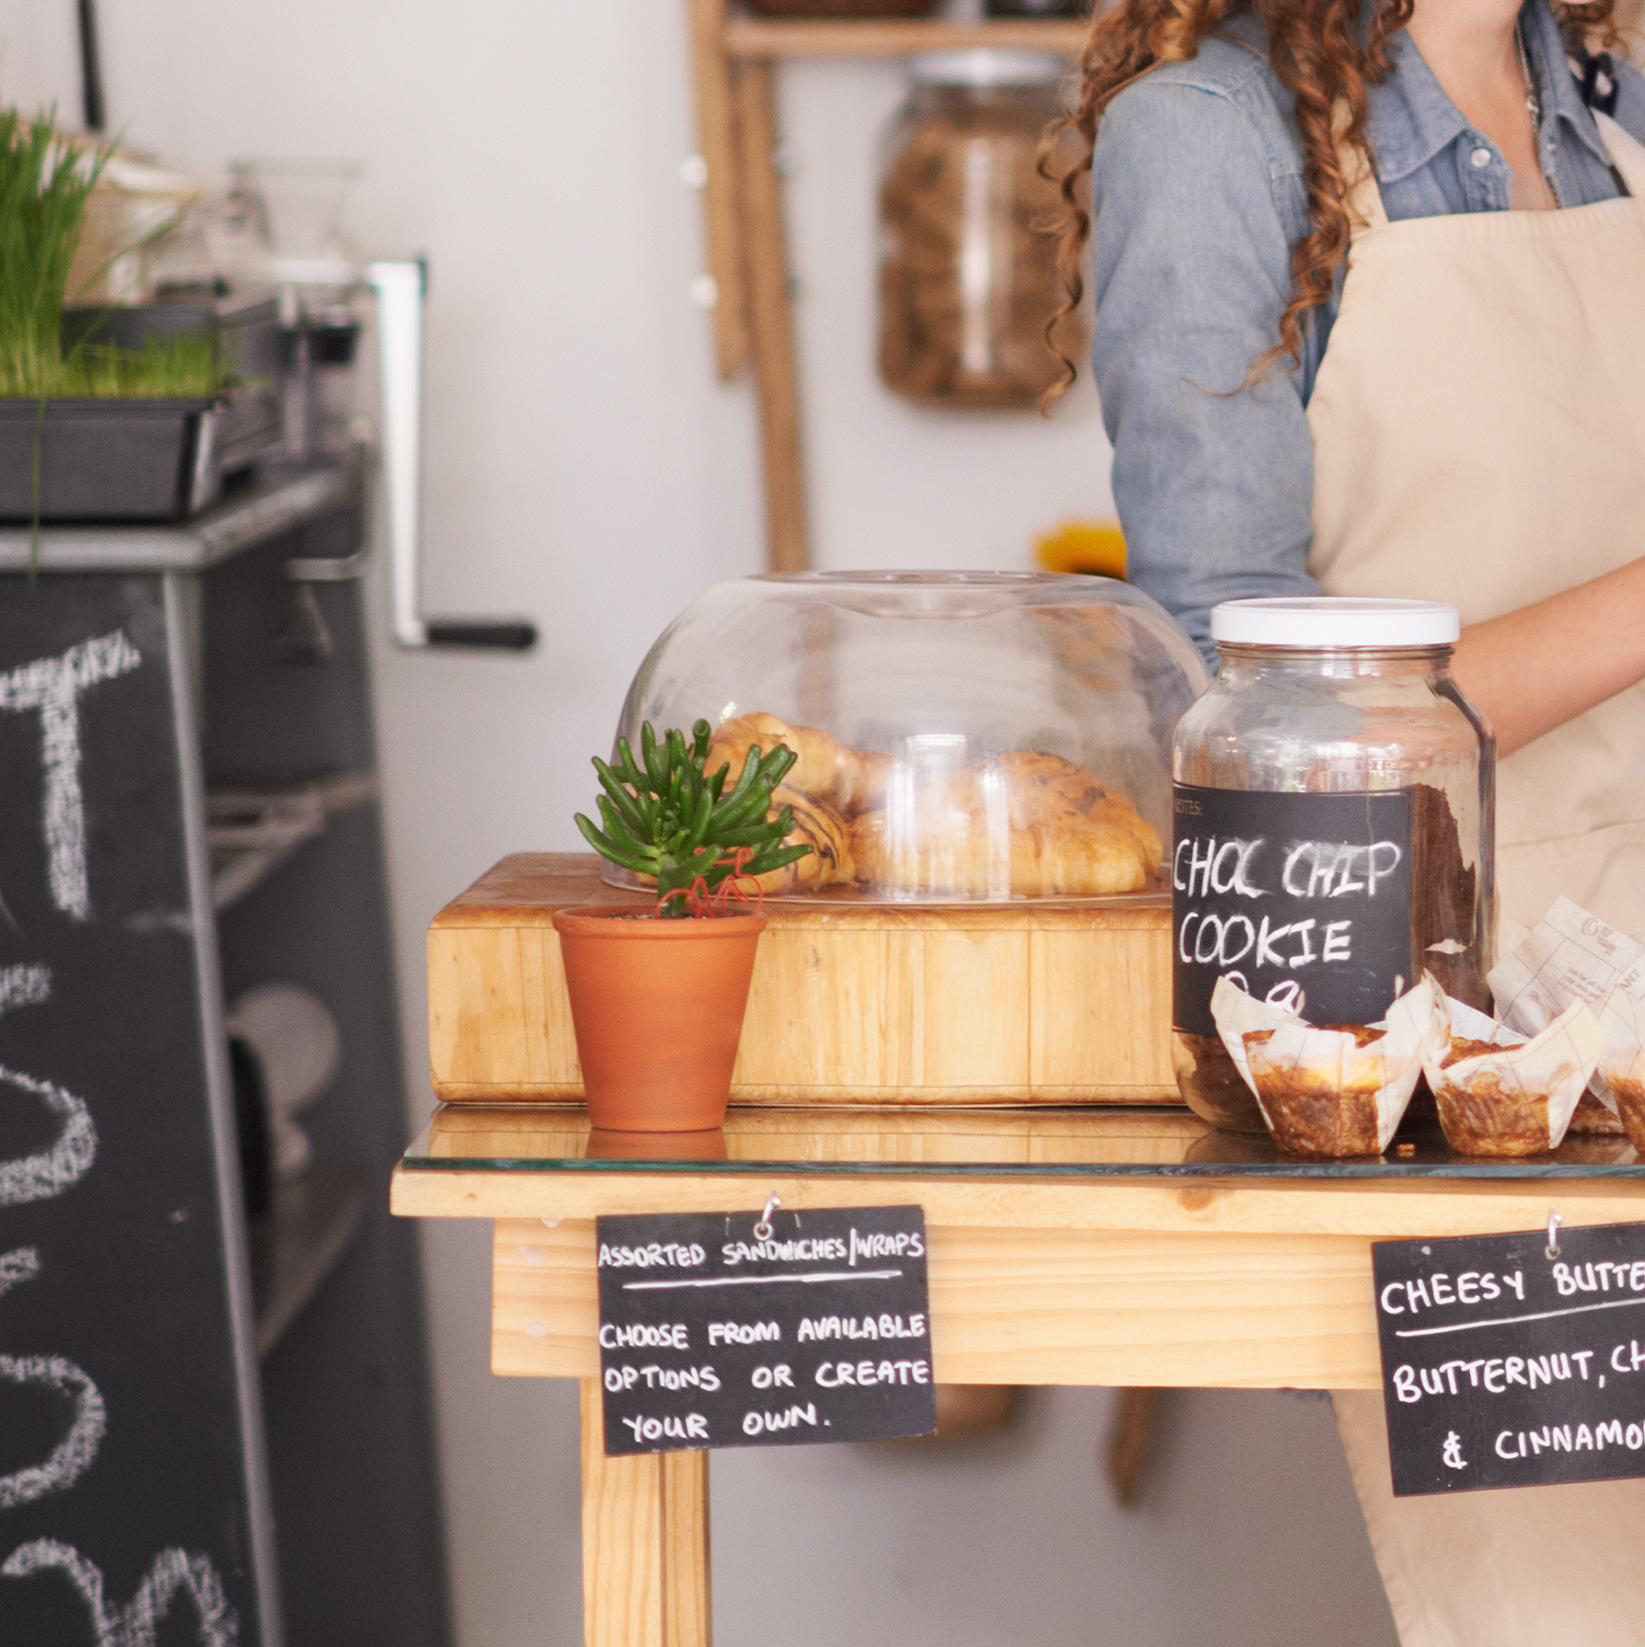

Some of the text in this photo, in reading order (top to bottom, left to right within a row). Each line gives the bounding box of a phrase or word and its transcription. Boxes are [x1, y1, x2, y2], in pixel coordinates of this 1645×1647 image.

[1174, 838, 1401, 898] CHOC CHIP
[1179, 912, 1352, 968] COOKIE
[598, 1228, 924, 1267] ASSORTED SANDWICHES/WRAPS
[1381, 1271, 1524, 1314] CHEESY
[599, 1314, 925, 1349] CHOOSE FROM AVAILABLE
[605, 1361, 928, 1391] OPTIONS OR CREATE
[1393, 1351, 1605, 1402] BUTTERNUT,
[623, 1403, 830, 1442] YOUR OWN.
[1443, 1431, 1467, 1469] &
